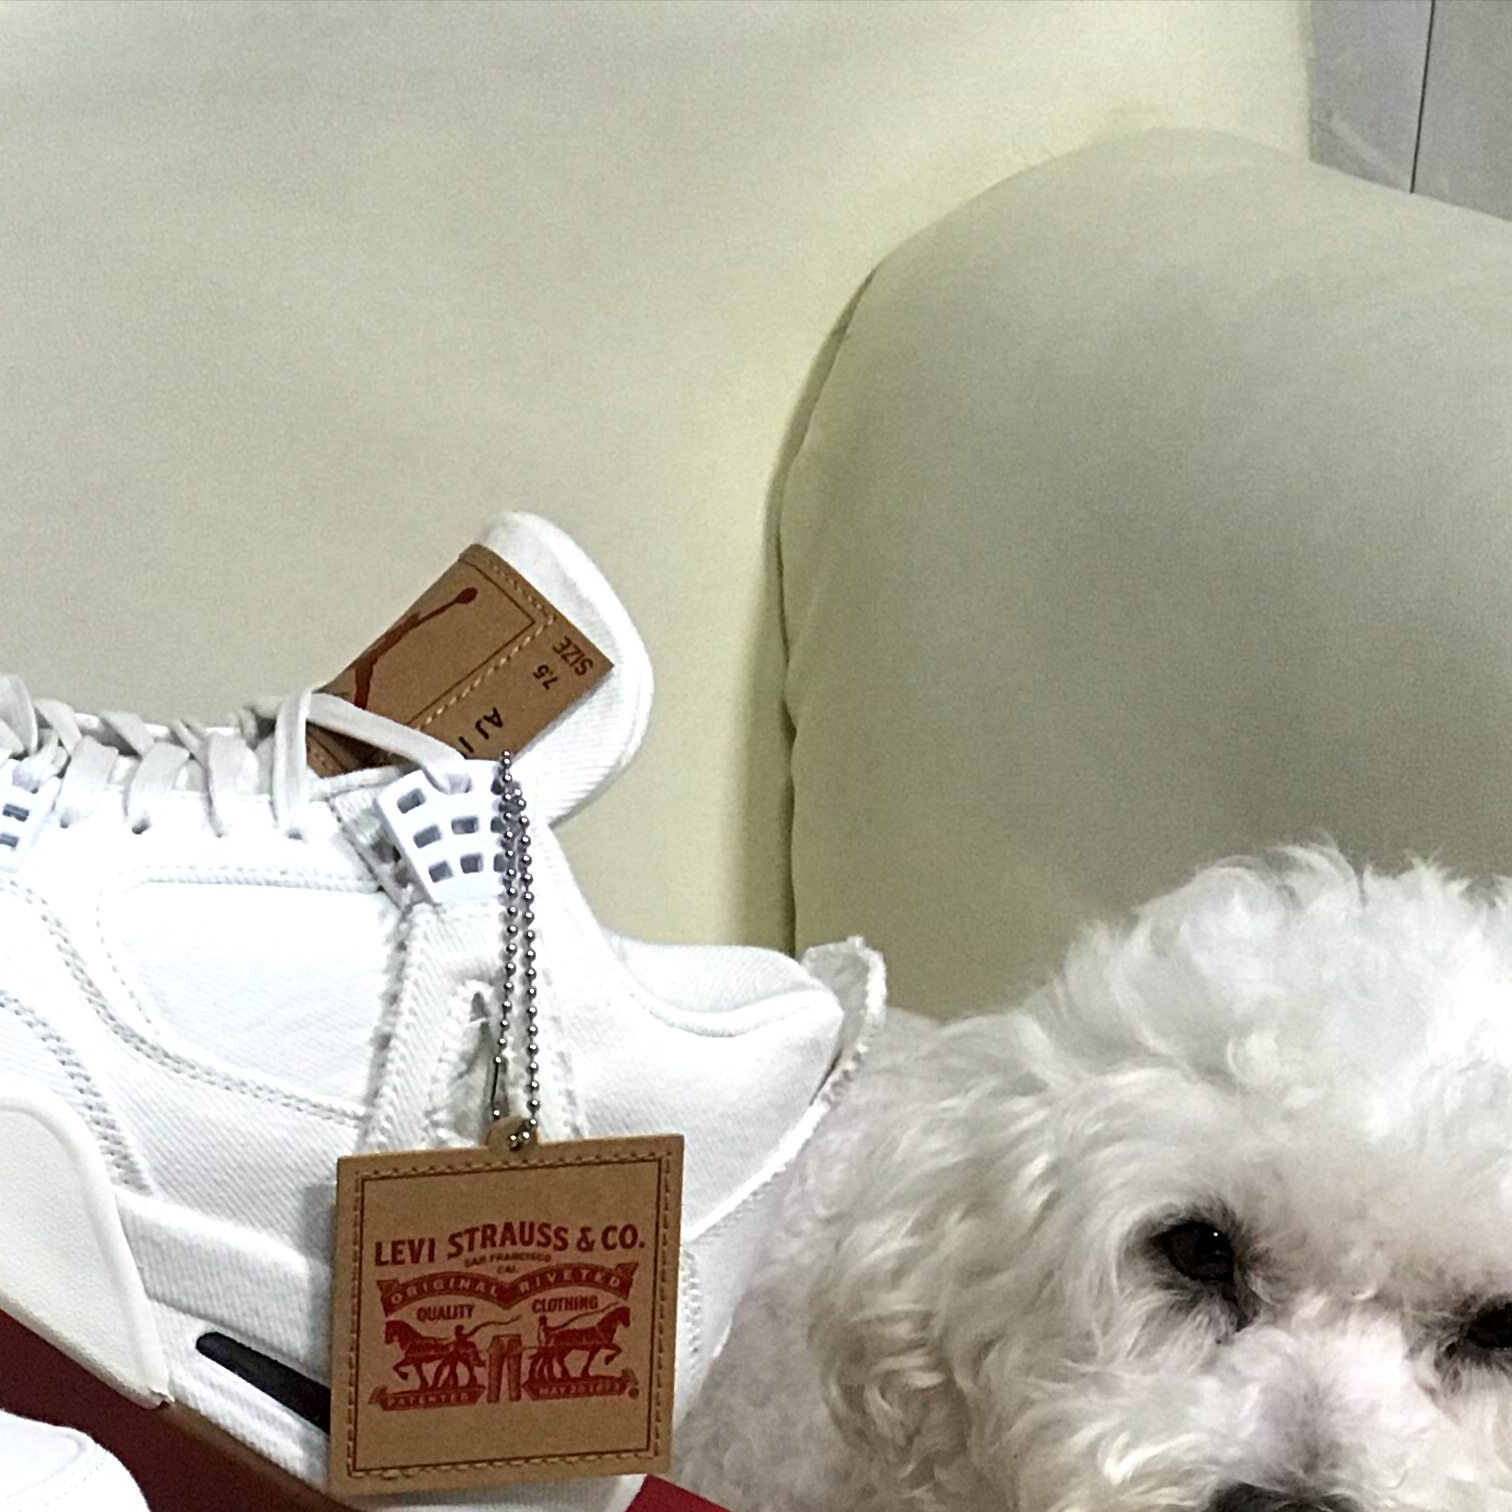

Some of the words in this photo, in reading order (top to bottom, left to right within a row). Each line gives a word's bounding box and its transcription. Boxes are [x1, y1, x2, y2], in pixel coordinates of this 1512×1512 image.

[551, 635, 594, 676] SIZE
[474, 707, 503, 740] AJ
[374, 1236, 436, 1267] LEVI
[447, 1220, 569, 1261] STRAUSS
[575, 1226, 596, 1251] &
[600, 1223, 645, 1251] CO.
[390, 1276, 499, 1305] ORIGINAL
[519, 1266, 621, 1294] RIVETED
[416, 1303, 475, 1322] QUALITY
[532, 1295, 599, 1314] CLOTHING
